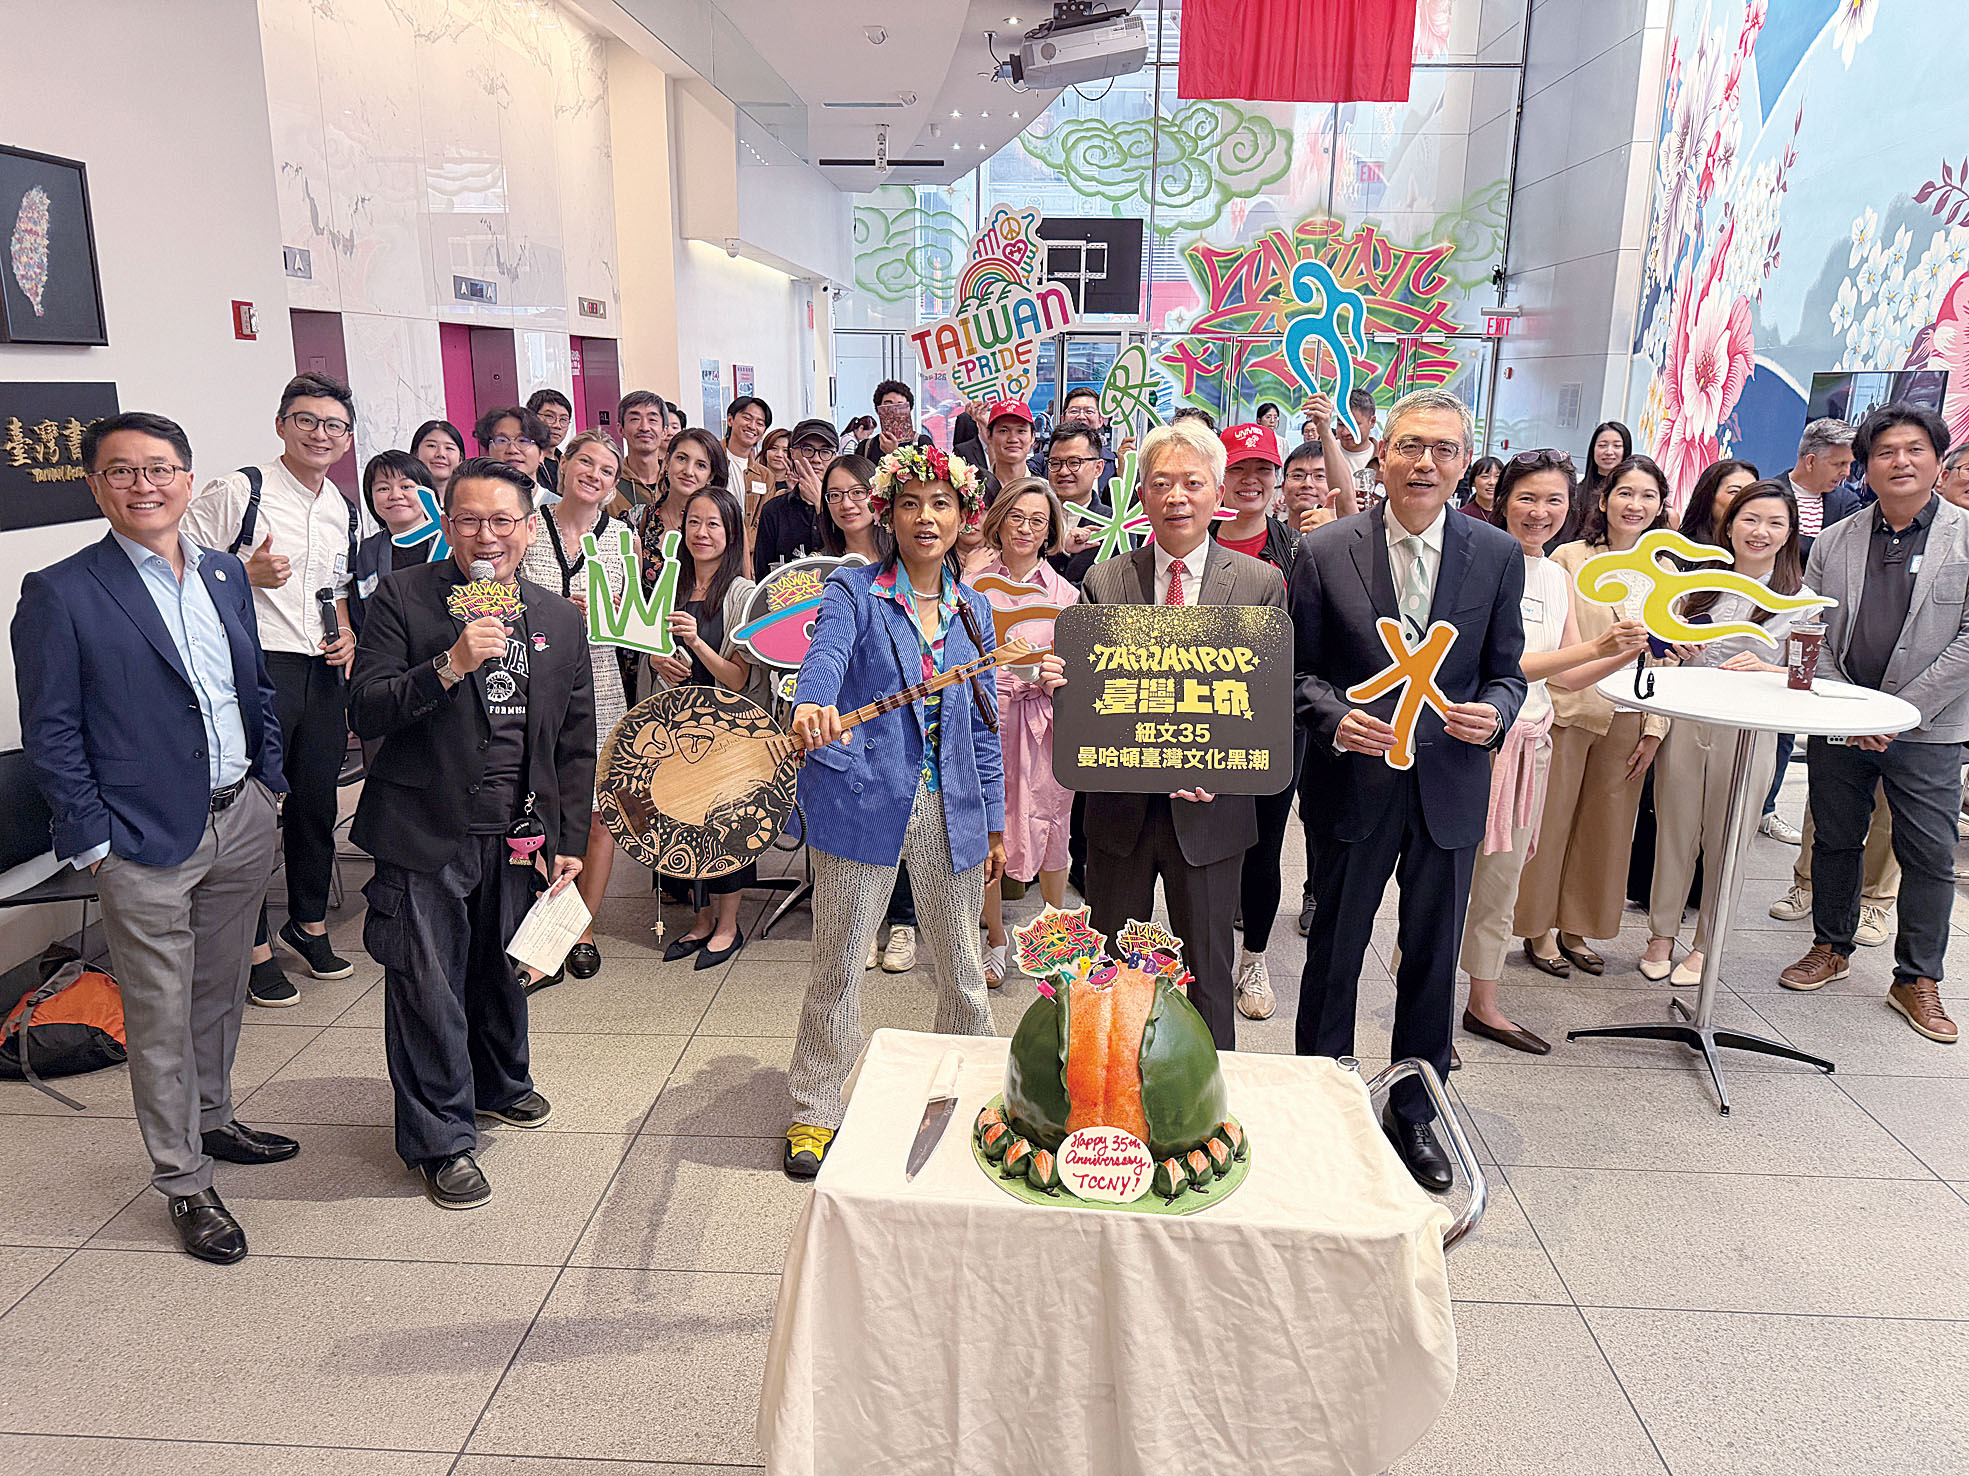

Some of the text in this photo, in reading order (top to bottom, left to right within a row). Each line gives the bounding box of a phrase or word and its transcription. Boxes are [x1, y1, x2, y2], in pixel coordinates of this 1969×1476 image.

[911, 288, 1071, 371] TAIWAN
[1486, 317, 1513, 336] EXIT
[957, 339, 1034, 382] PRIDE
[3, 417, 104, 467] 臺灣書
[1134, 722, 1211, 744] 紐文35
[1077, 746, 1270, 771] 曼哈頓臺灣文化黑潮
[1070, 1132, 1141, 1156] Happy 35th
